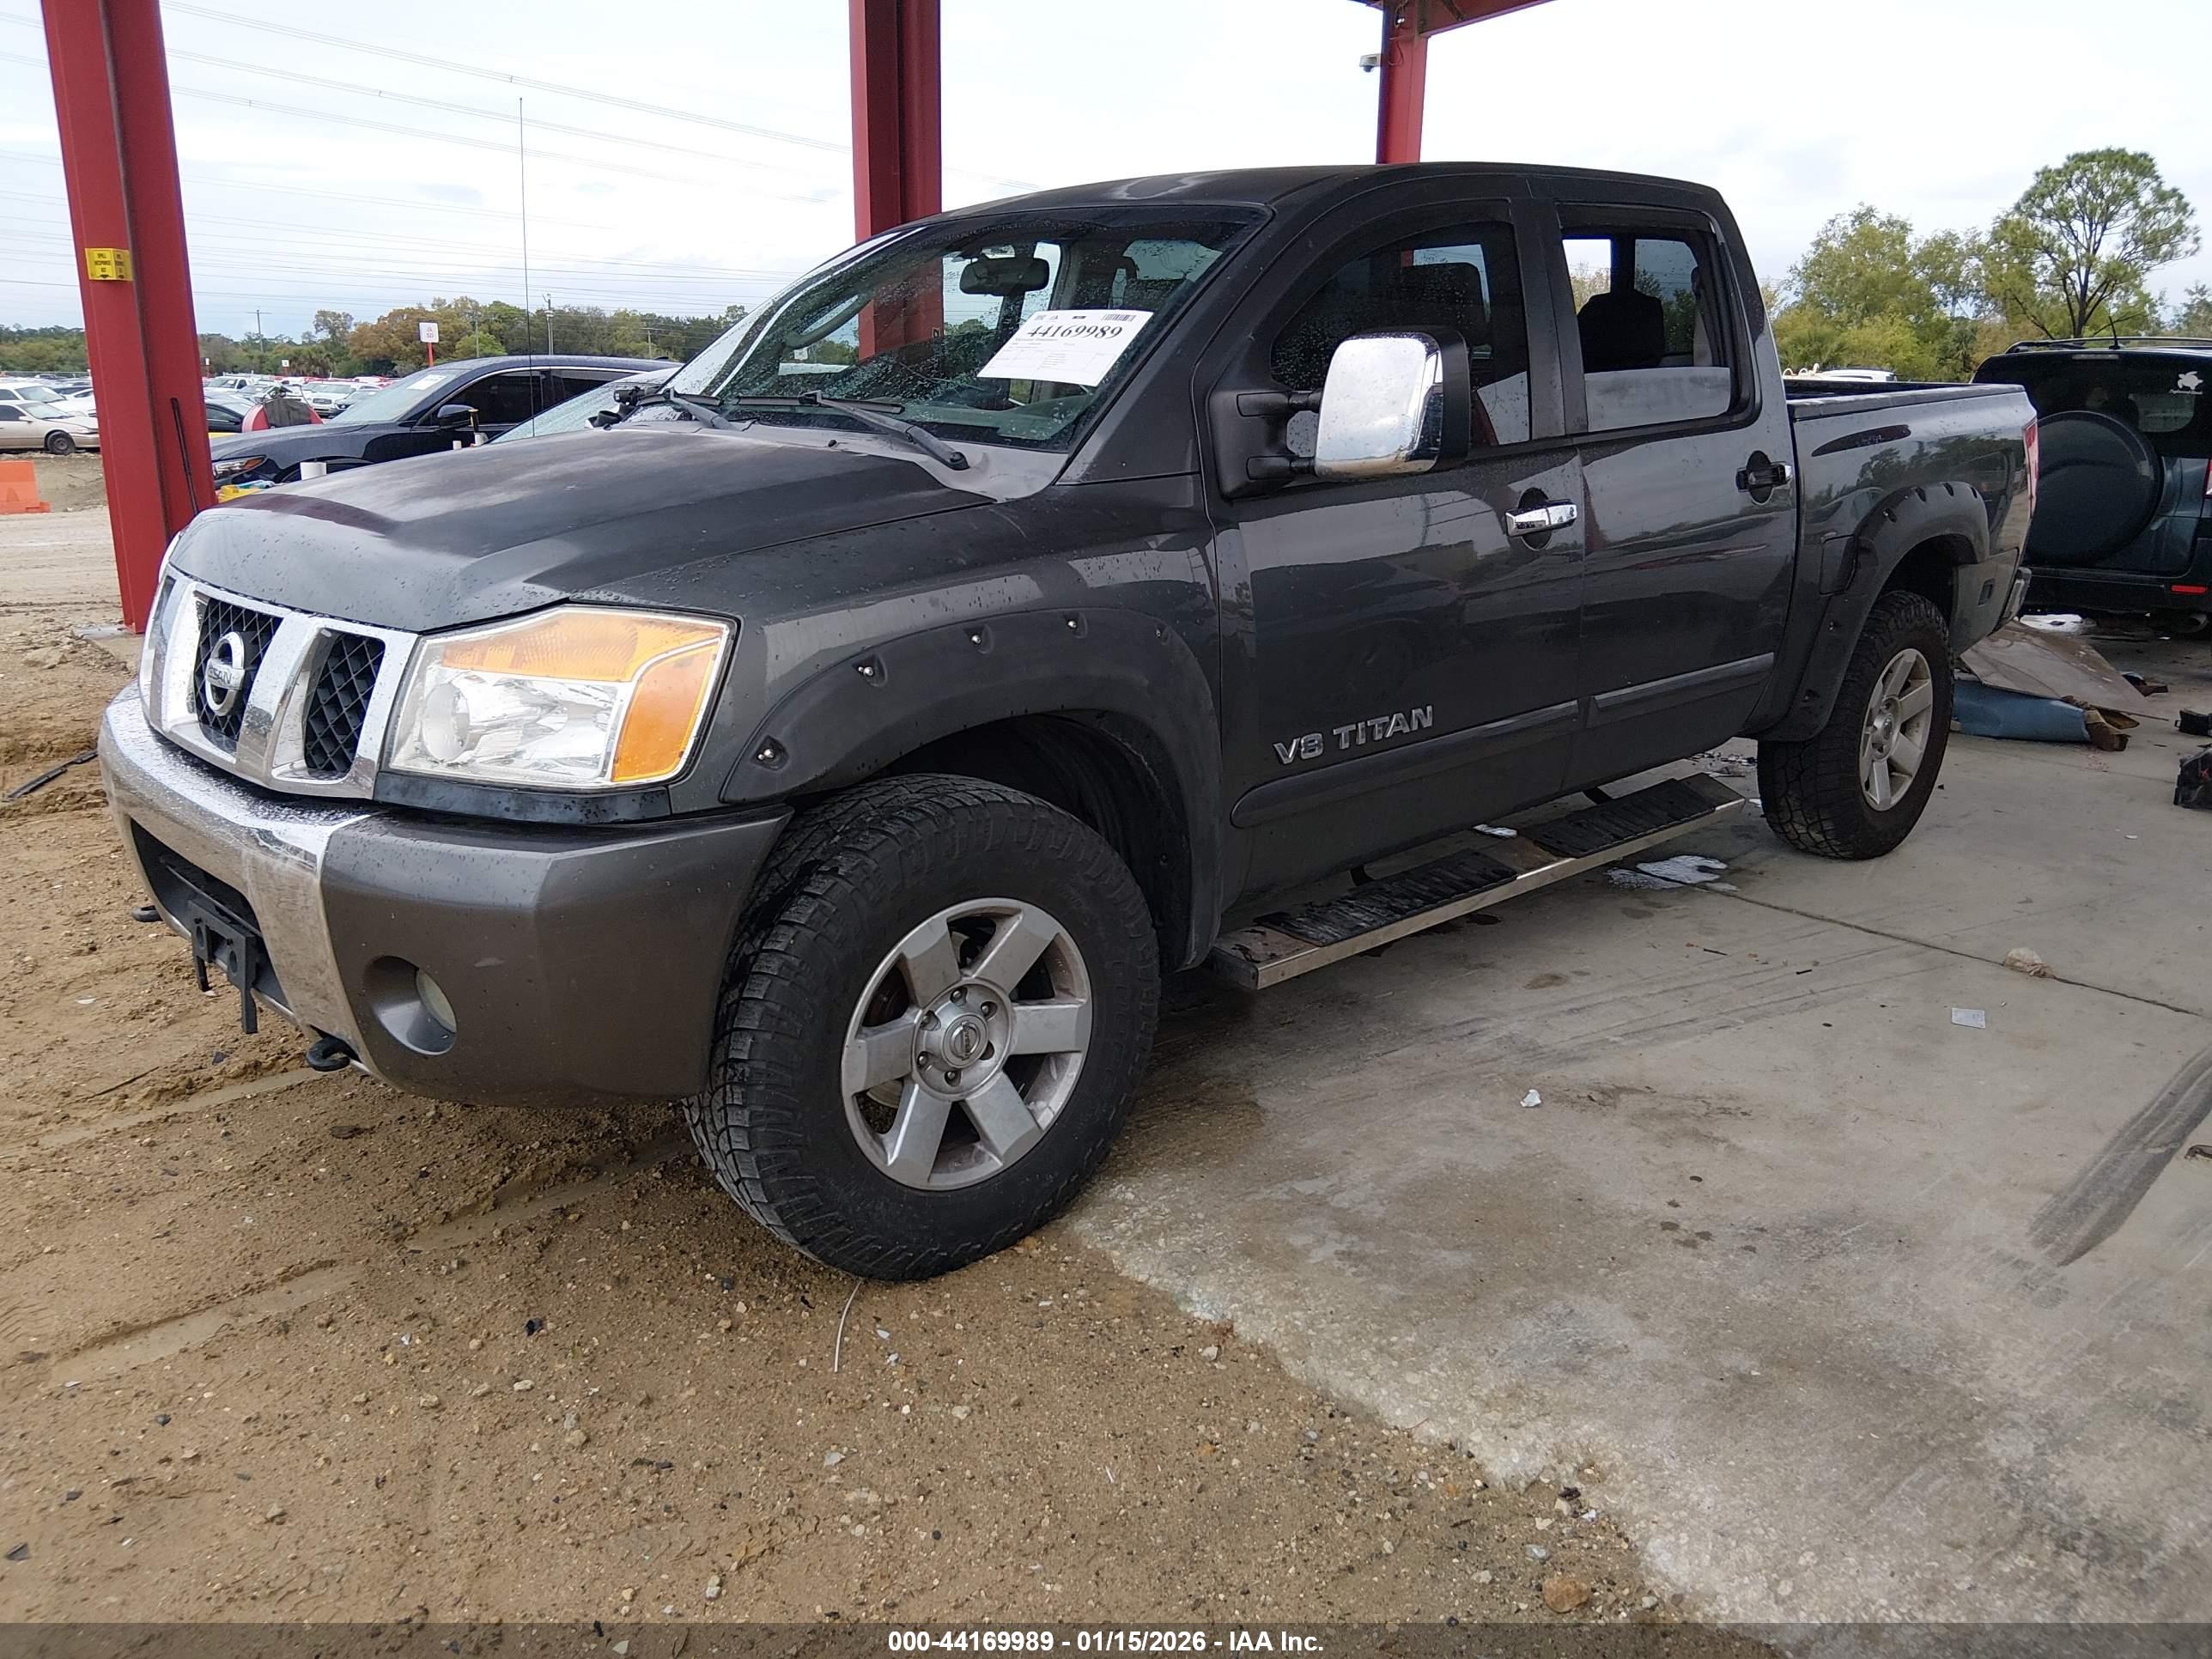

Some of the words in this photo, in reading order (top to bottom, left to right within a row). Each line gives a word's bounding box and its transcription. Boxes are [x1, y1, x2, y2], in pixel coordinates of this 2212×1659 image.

[1027, 325, 1123, 339] 44169989
[1273, 732, 1324, 765] V8
[1333, 705, 1433, 750] TITAN
